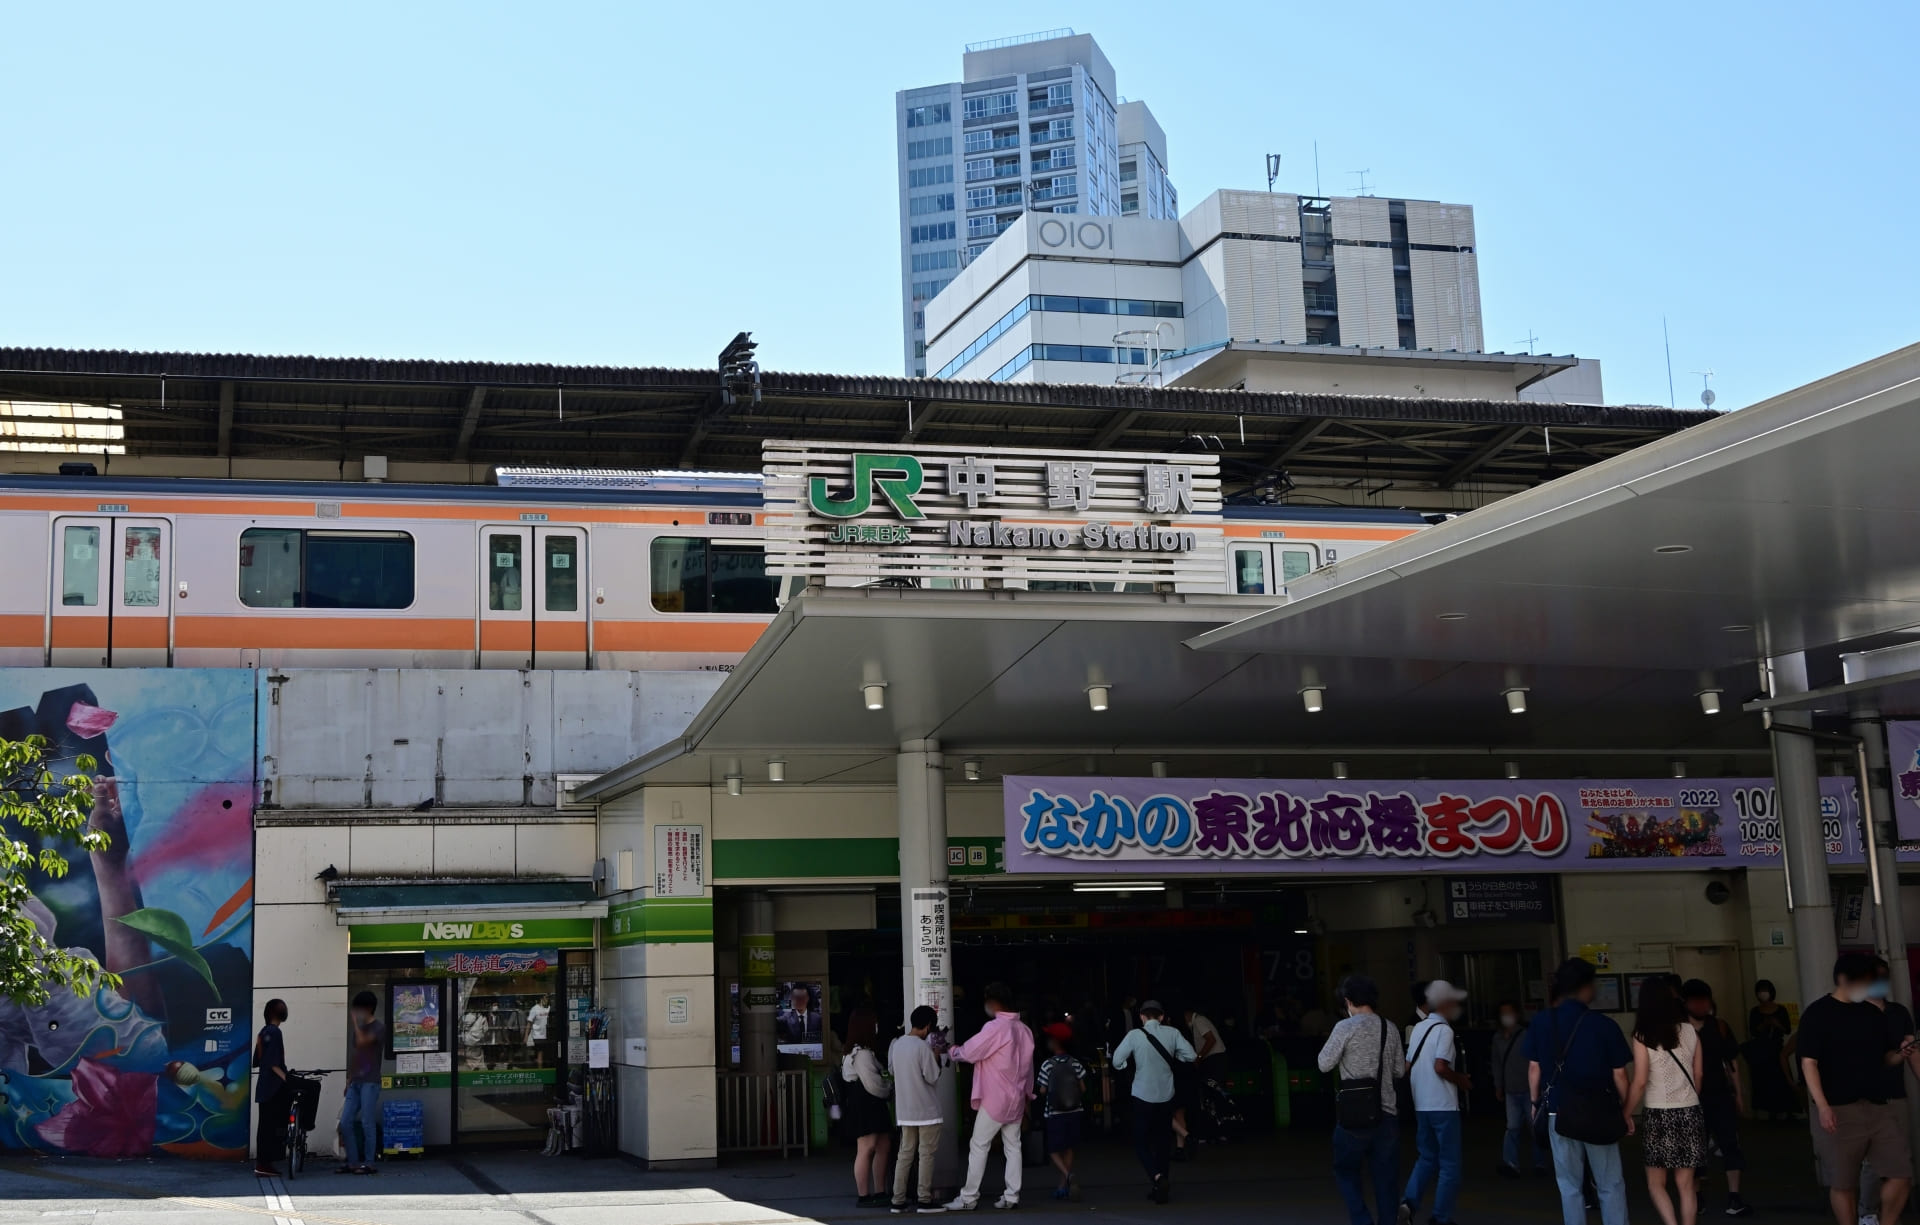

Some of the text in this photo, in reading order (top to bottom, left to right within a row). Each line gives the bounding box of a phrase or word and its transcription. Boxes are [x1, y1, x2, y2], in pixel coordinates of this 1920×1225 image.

[807, 453, 927, 520] JR
[946, 456, 1195, 515] 中野駅
[829, 524, 911, 544] JR東日本
[949, 520, 1198, 552] Nakano Station
[1327, 551, 1335, 560] 4
[1680, 789, 1719, 807] 2022
[1735, 789, 1777, 817] 10/
[1821, 797, 1840, 815] 土)
[1023, 792, 1566, 855] なかの東北応援まつり
[951, 851, 983, 860] JC JB
[1825, 844, 1842, 853] :30
[423, 922, 524, 942] NewDays
[920, 915, 932, 945] あちら
[934, 904, 945, 945] 喫煙所は
[448, 953, 534, 974] 北海道フェア
[209, 1010, 229, 1020] CYC
